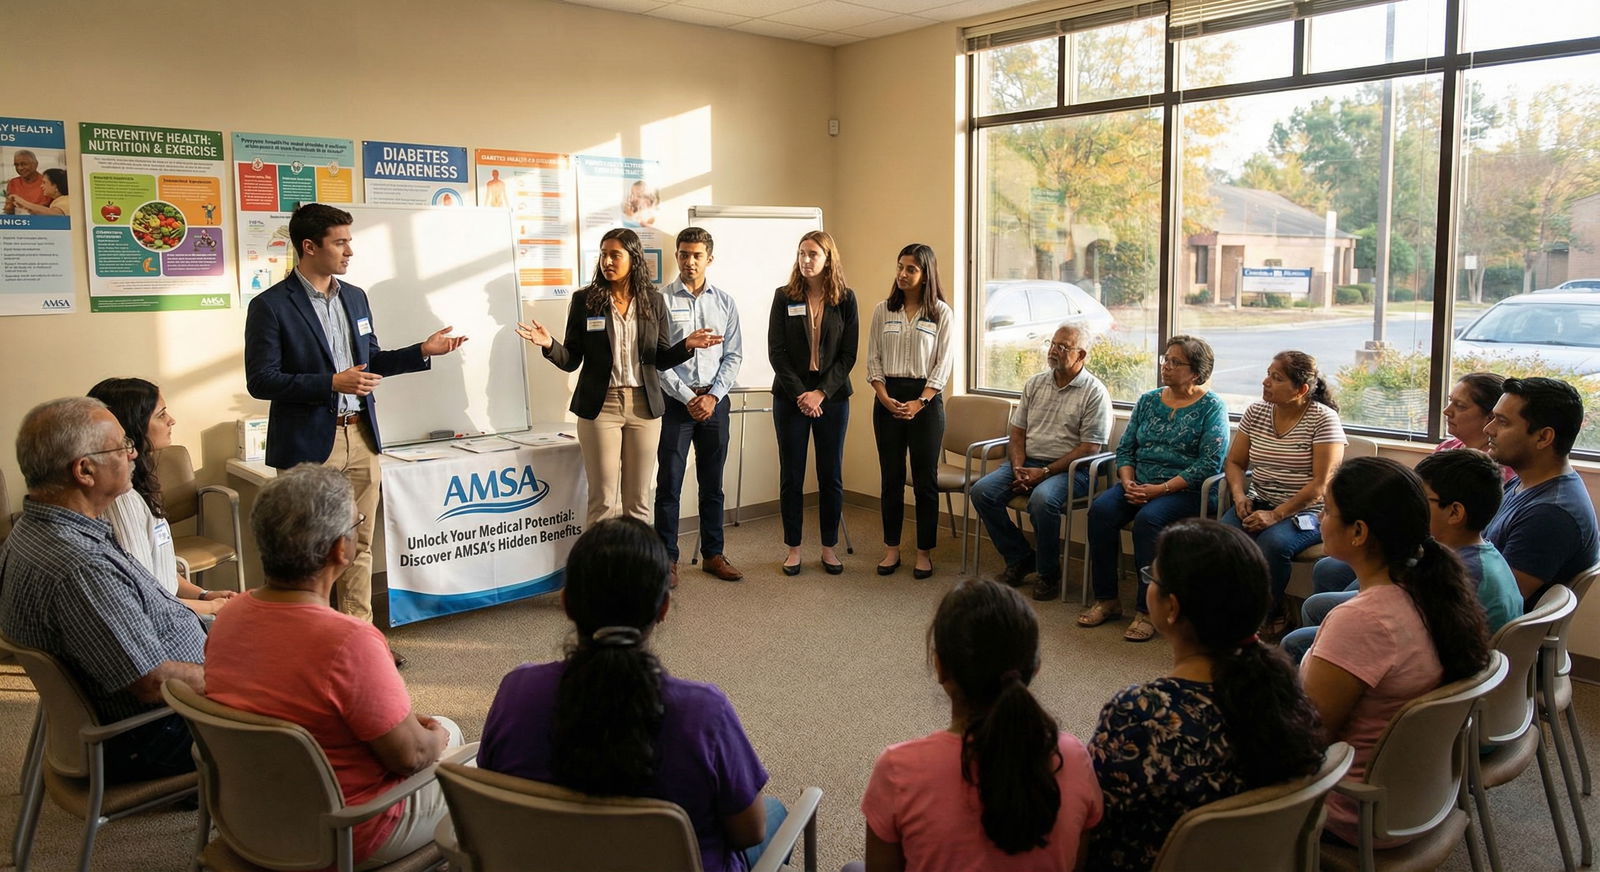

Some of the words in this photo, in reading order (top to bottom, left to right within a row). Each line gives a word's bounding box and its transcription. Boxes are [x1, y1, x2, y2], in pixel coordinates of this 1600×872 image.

[11, 125, 53, 134] HEALTH
[93, 128, 164, 143] PREVENTIVE
[166, 132, 212, 145] HEALTH:
[88, 140, 151, 154] NUTRITION
[153, 144, 162, 154] &
[165, 144, 218, 157] EXERCISE
[383, 147, 450, 164] DIABETES
[374, 161, 458, 179] AWARENESS
[42, 299, 71, 307] AMSA
[443, 465, 540, 507] AMSA
[407, 532, 449, 550] Unlock
[450, 529, 477, 543] Your
[479, 518, 523, 536] Medical
[525, 509, 575, 529] Potential:
[400, 549, 451, 567] Discover
[454, 541, 496, 559] AMSA’s
[499, 532, 538, 551] Hidden
[540, 524, 582, 543] Benefits
